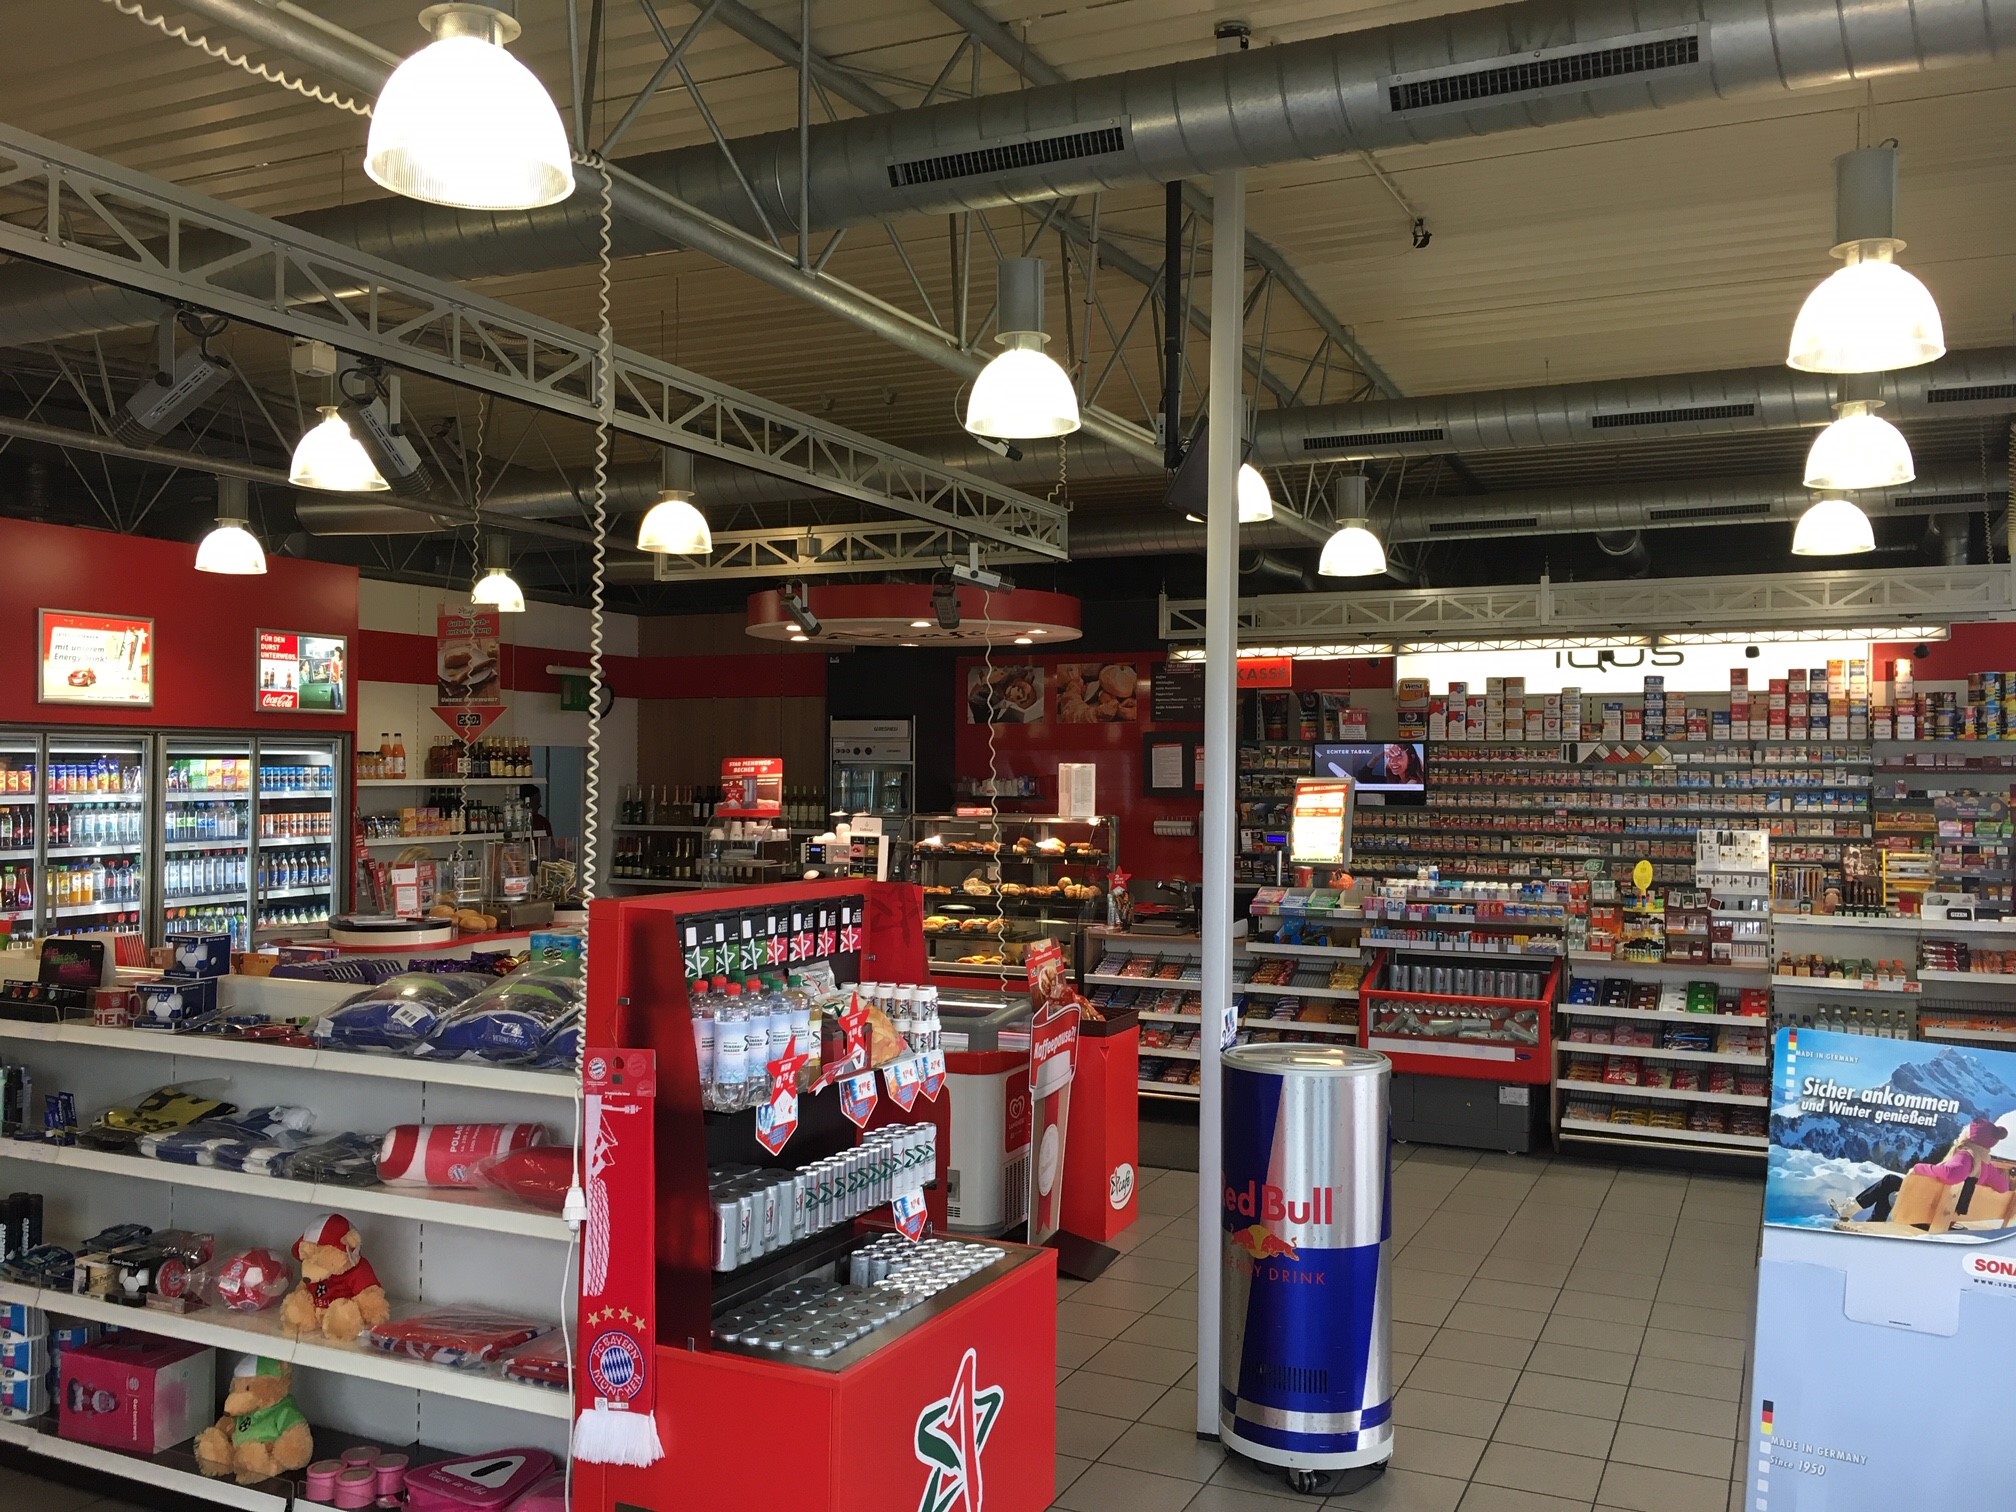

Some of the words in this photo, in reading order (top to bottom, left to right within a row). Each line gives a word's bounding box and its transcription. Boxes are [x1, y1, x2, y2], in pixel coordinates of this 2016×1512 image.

[261, 634, 272, 642] FÜR
[261, 643, 280, 651] DURST
[1795, 1050, 1813, 1058] MADE
[1826, 1054, 1859, 1063] GERMANY
[781, 1062, 792, 1072] NUR
[1802, 1076, 1856, 1101] Sicher
[1861, 1086, 1960, 1113] ankommen
[1801, 1100, 1824, 1113] und
[1829, 1103, 1872, 1118] Winter
[1875, 1110, 1938, 1127] genießen!
[1262, 1184, 1333, 1225] Bull
[1269, 1267, 1326, 1285] DRINK
[1974, 1258, 2016, 1276] SON
[593, 1343, 605, 1358] FC
[603, 1335, 640, 1360] BAYERN
[1770, 1436, 1798, 1451] MADE
[1802, 1443, 1813, 1454] IN
[1817, 1446, 1868, 1466] GERMANY
[1770, 1455, 1794, 1469] Since
[1798, 1460, 1826, 1476] 1950
